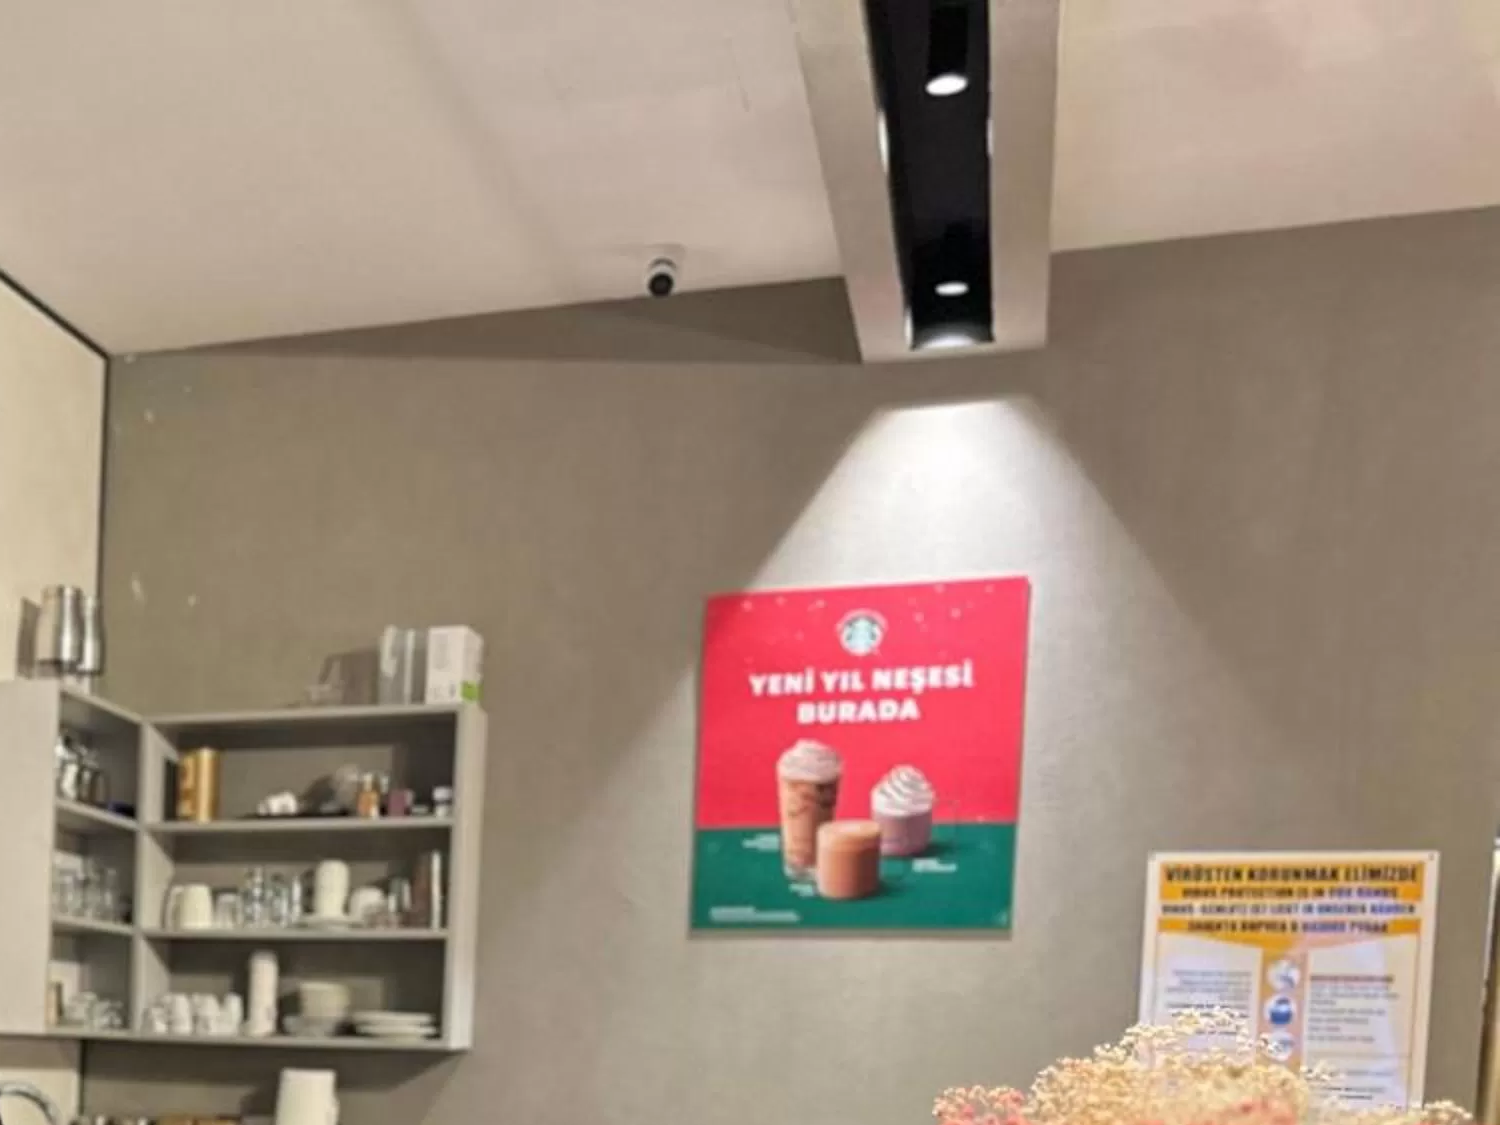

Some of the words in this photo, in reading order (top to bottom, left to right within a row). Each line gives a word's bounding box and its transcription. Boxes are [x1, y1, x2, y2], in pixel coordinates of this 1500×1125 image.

[749, 667, 815, 696] YENİ
[820, 671, 864, 692] YIL
[872, 659, 974, 695] NEŞESİ
[797, 699, 921, 725] BURADA
